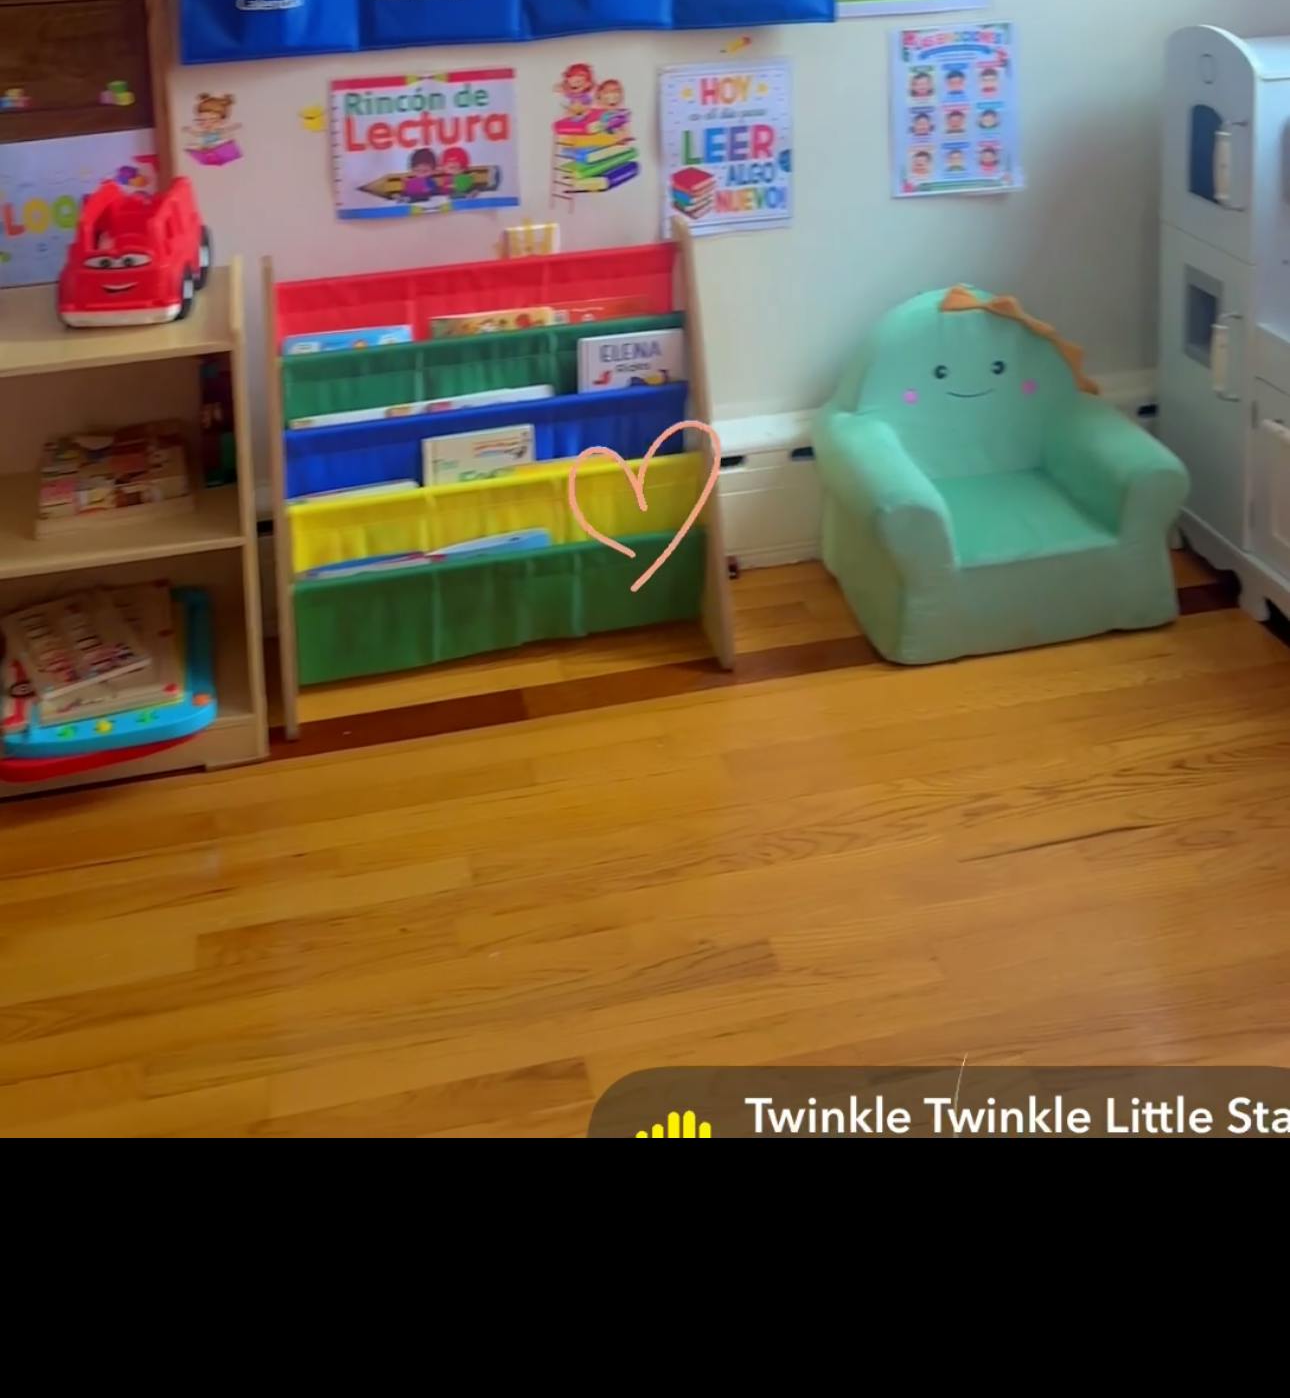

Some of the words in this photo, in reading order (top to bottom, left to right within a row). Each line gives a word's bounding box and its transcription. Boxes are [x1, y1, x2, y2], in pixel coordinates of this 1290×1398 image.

[343, 86, 446, 116] Rincón
[453, 83, 489, 108] de
[699, 76, 754, 106] HOY
[344, 110, 510, 153] Lectura
[682, 123, 775, 166] LEER
[724, 162, 776, 187] ALGO
[600, 340, 663, 363] ELENA
